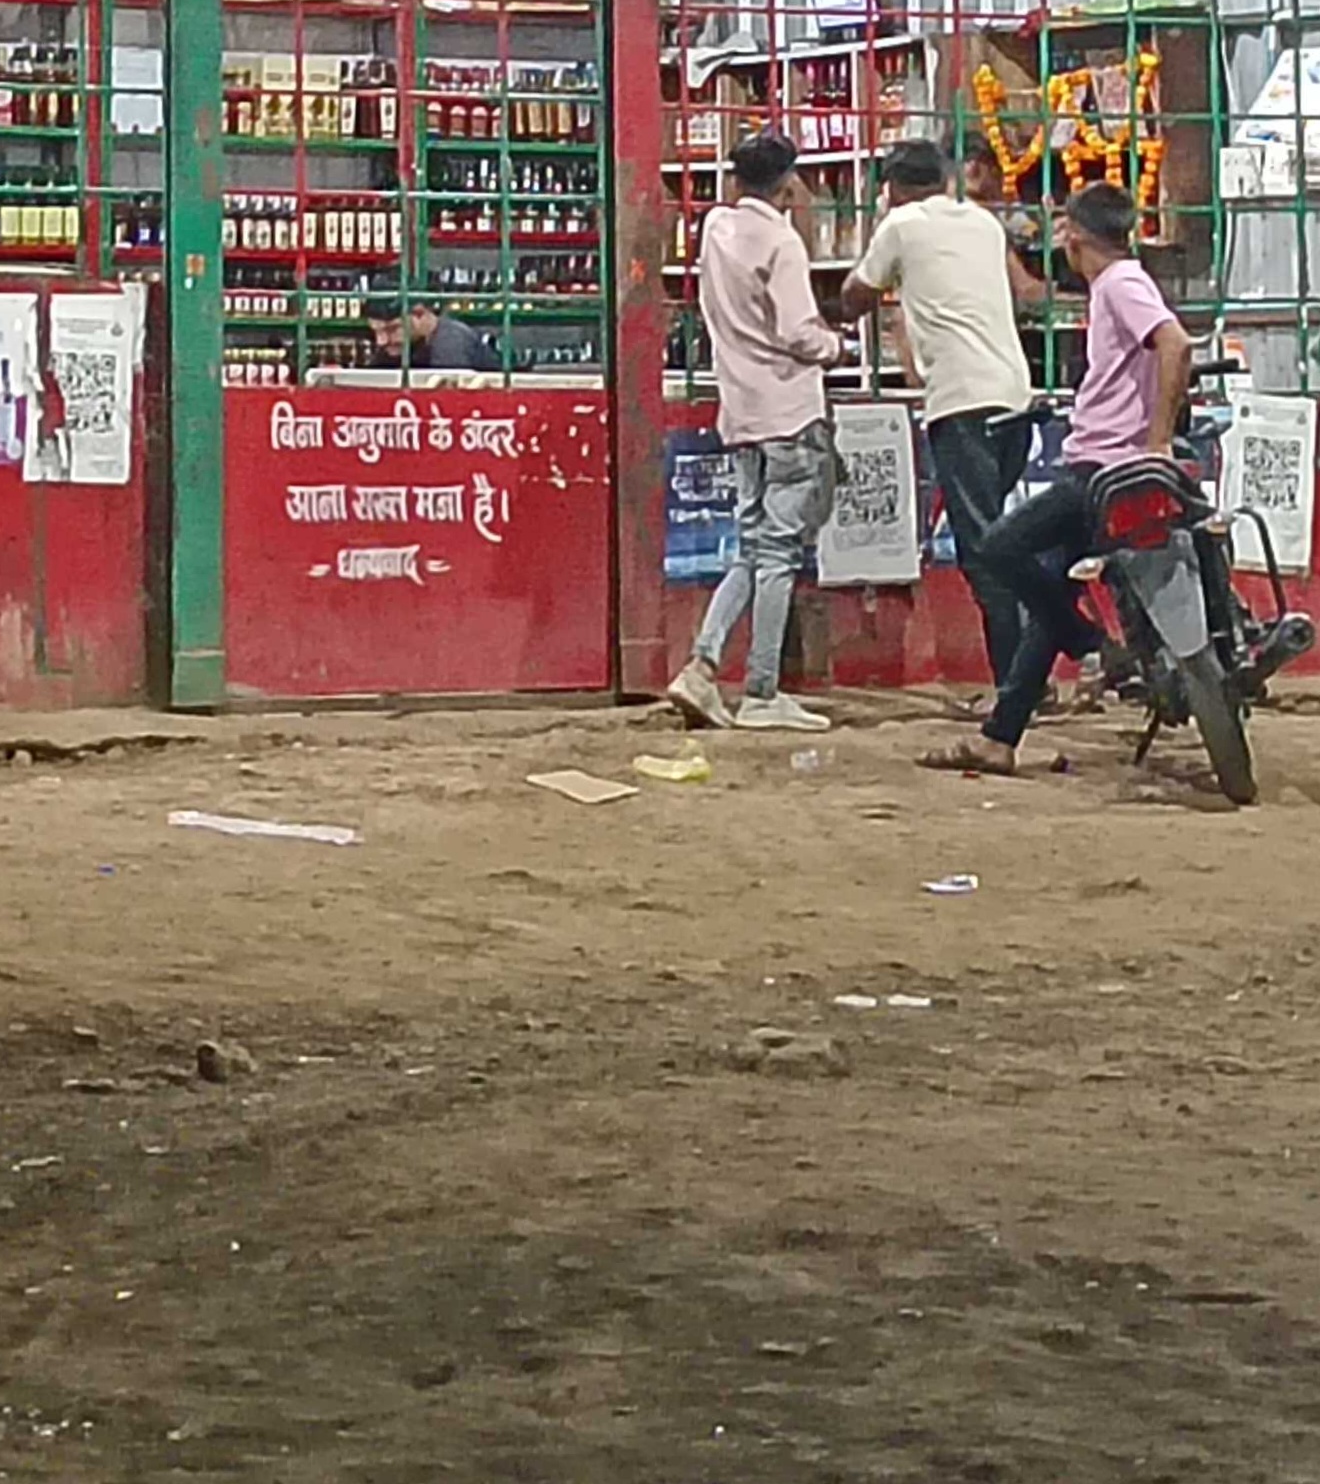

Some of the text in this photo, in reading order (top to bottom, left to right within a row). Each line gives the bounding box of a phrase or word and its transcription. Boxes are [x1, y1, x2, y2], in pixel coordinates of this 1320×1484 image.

[270, 401, 323, 451] बिना
[332, 399, 420, 463] अनुमति
[428, 403, 453, 452] के
[285, 484, 348, 522] आना
[412, 485, 466, 522] मना
